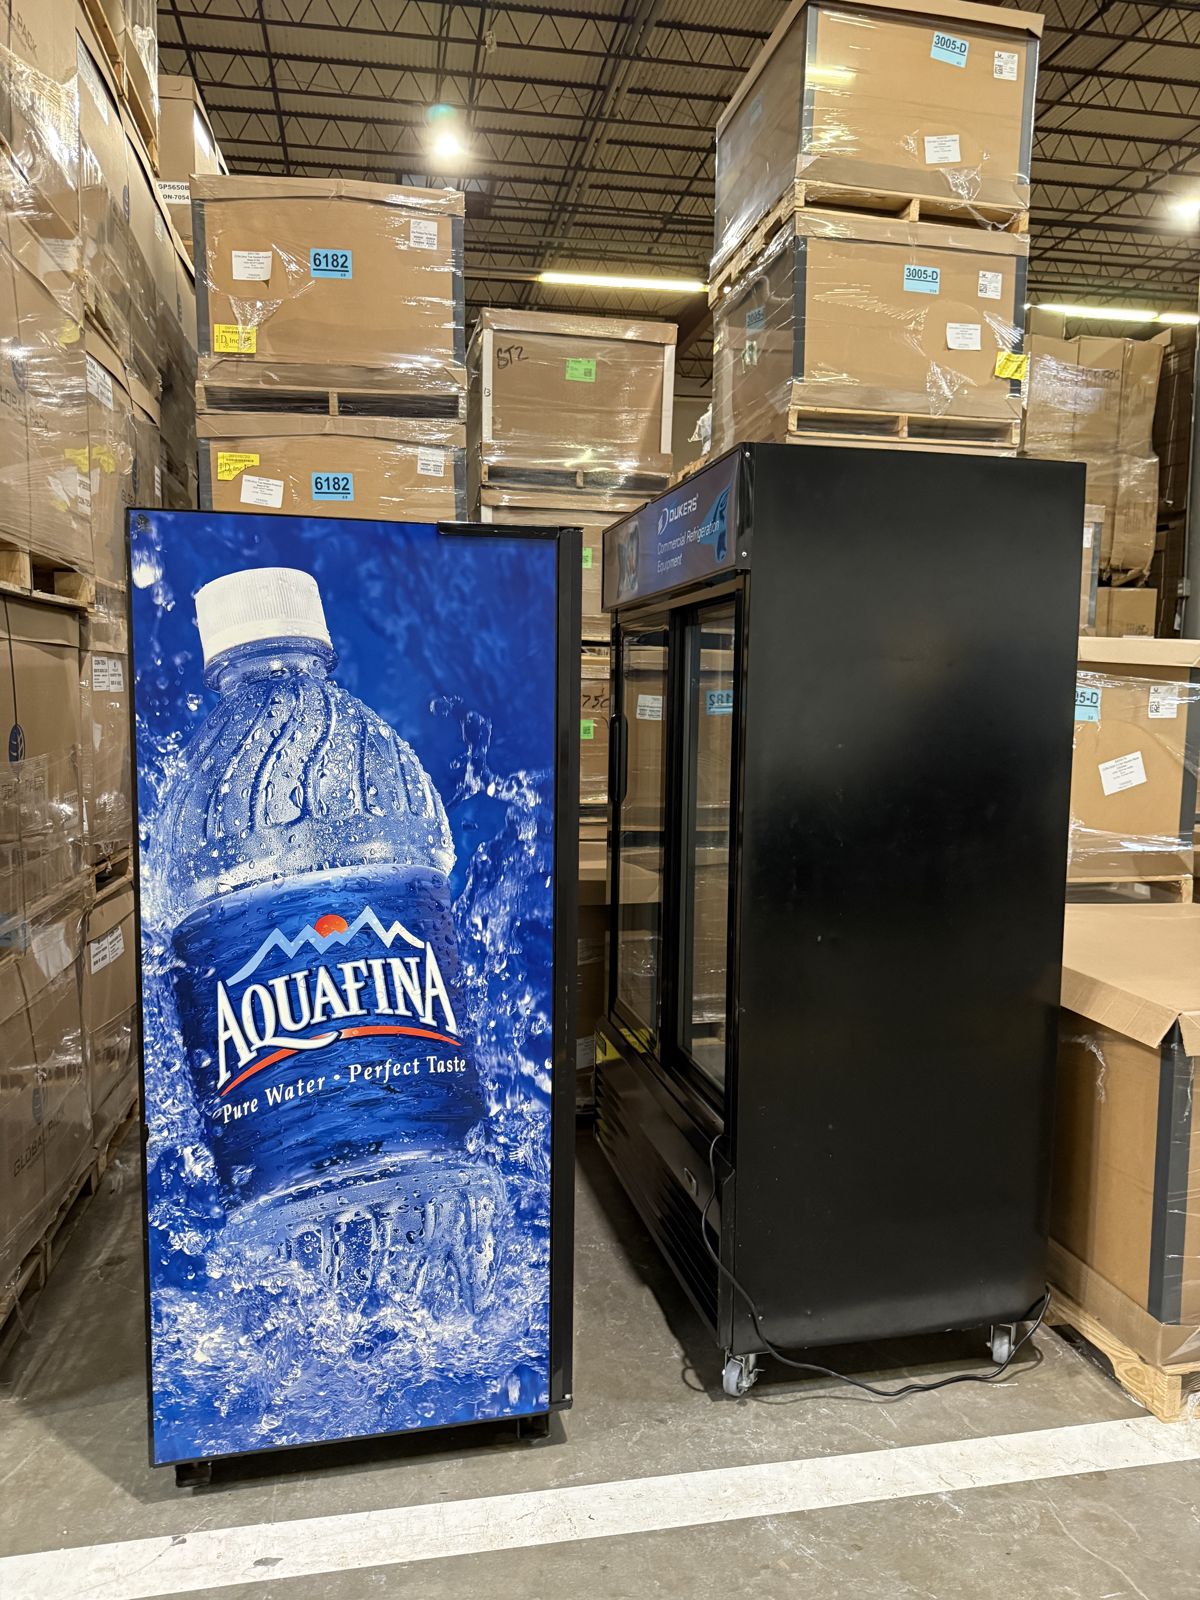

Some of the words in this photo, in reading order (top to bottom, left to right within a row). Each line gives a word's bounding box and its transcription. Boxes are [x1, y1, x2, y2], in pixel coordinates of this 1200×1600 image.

[934, 34, 967, 53] 3005-D
[313, 252, 349, 268] 6182
[905, 267, 939, 281] 3005-D
[314, 476, 350, 491] 6182
[668, 496, 698, 523] DUKERS
[657, 531, 687, 556] Commercial
[686, 519, 720, 544] Refrigeration
[657, 552, 683, 576] Equipment
[216, 941, 458, 1090] AQUAFINA
[221, 1097, 259, 1124] Pure
[265, 1075, 326, 1106] Water
[348, 1058, 420, 1084] Perfect
[426, 1055, 466, 1074] Taste
